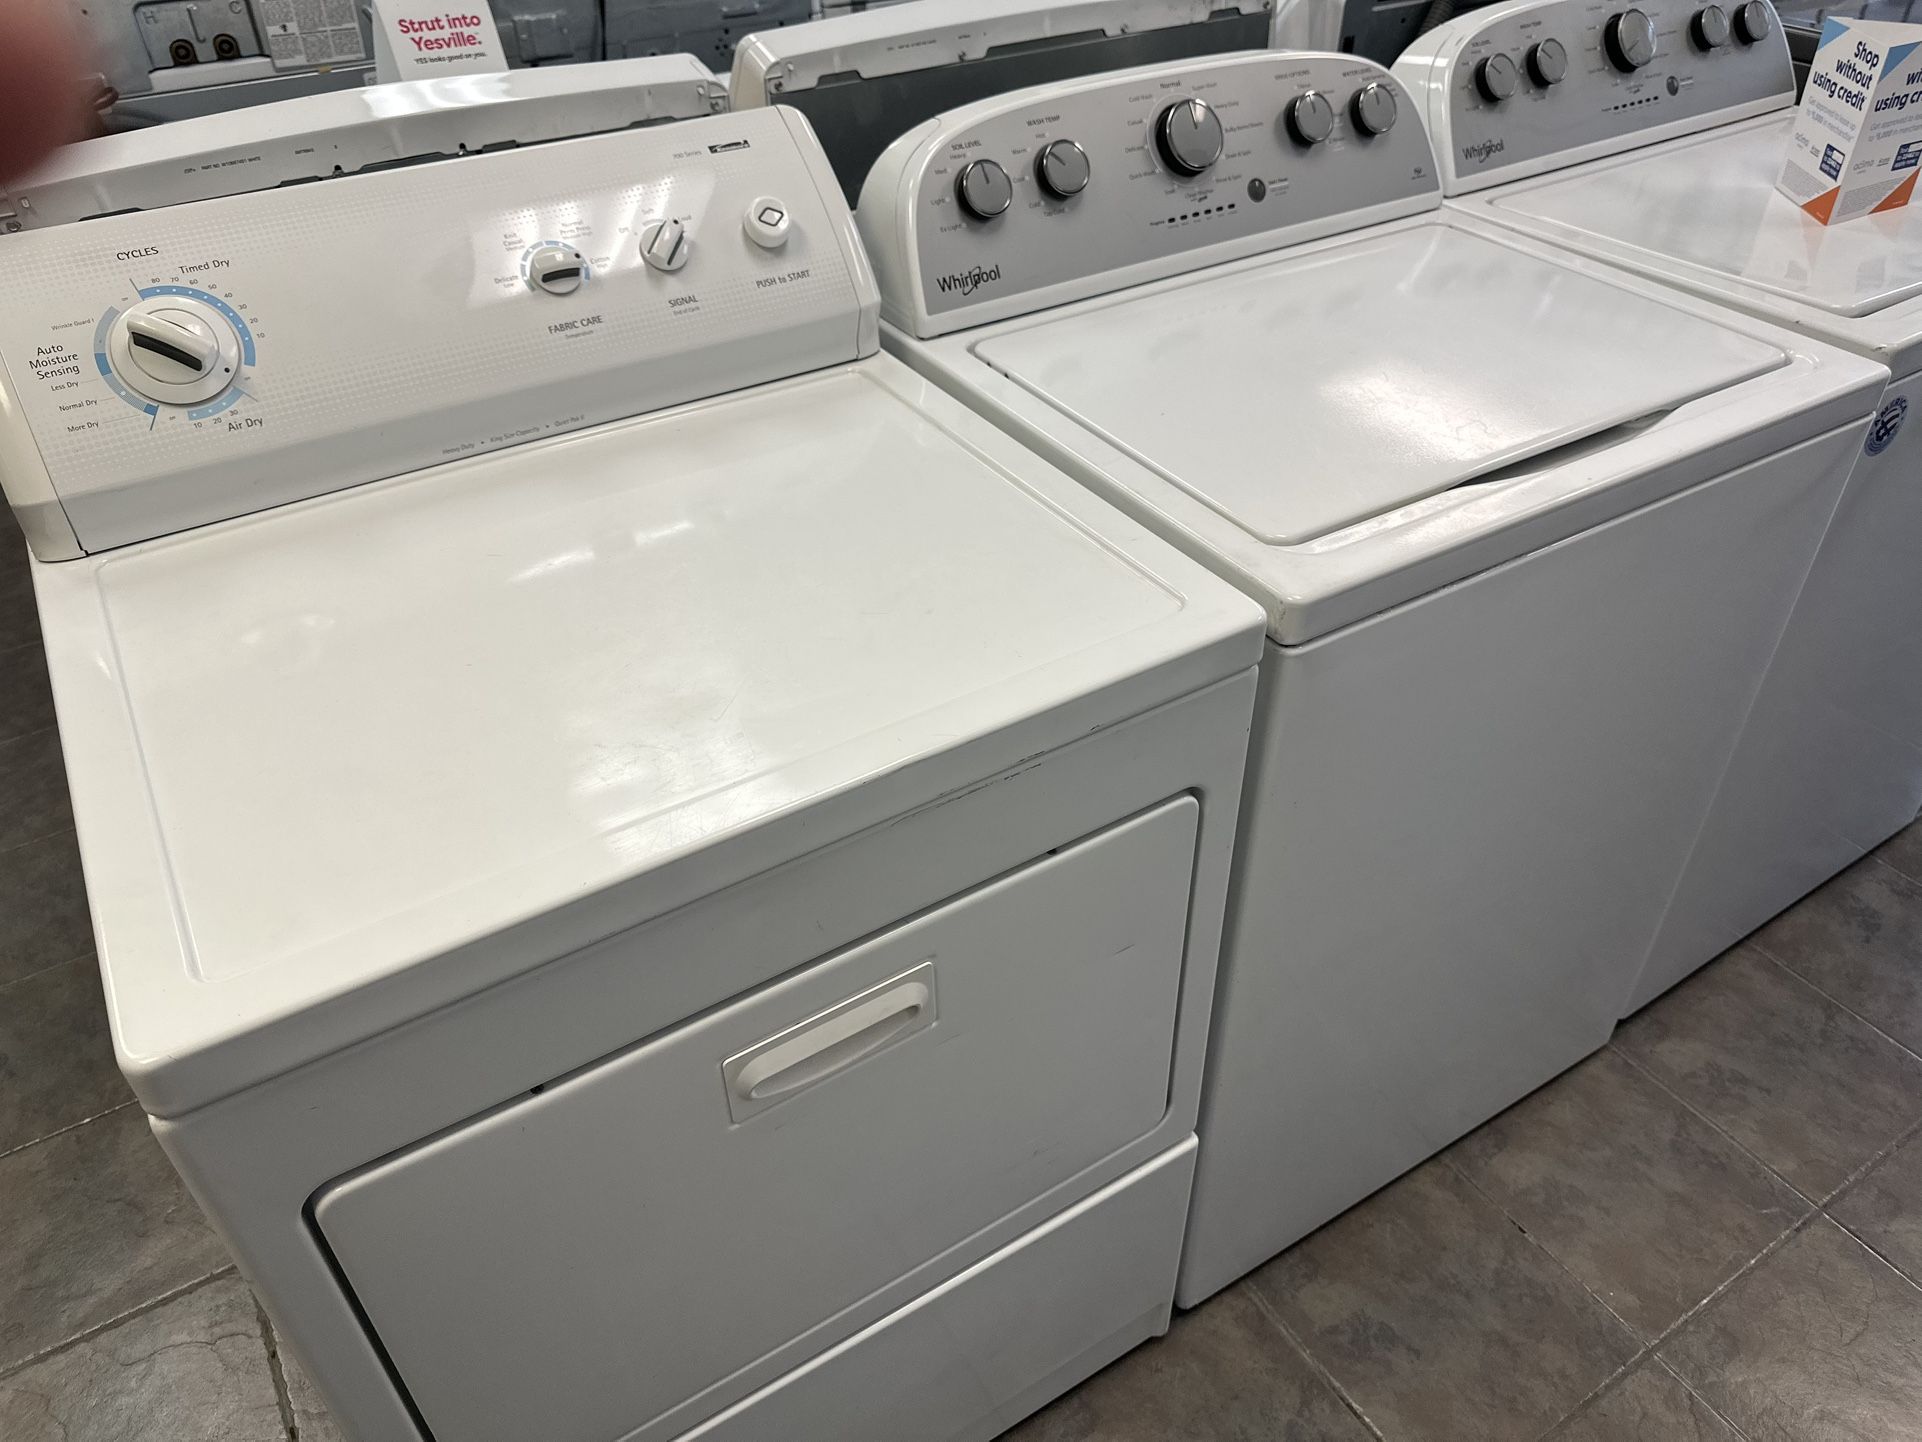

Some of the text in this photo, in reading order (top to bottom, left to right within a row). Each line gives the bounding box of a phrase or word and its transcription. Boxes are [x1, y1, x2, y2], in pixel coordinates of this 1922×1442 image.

[398, 13, 481, 34] Strut into
[411, 31, 482, 52] Yesville.
[1854, 40, 1880, 69] Shop
[1835, 58, 1874, 91] without
[1160, 80, 1181, 89] Normal
[1812, 69, 1866, 111] using credit
[1874, 91, 1909, 112] using
[964, 139, 982, 149] LEVEL
[1462, 139, 1504, 163] Whirlpool
[116, 246, 159, 261] CYCLES
[178, 258, 231, 274] Timed Dry
[756, 269, 811, 289] PUSH to START
[936, 264, 1001, 296] Whirlpool
[668, 294, 699, 308] SIGNAL
[51, 323, 73, 331] Wrinkle
[73, 319, 91, 327] Guard
[548, 314, 604, 334] FABRIC CARE
[37, 344, 64, 356] Auto
[29, 352, 79, 370] Moisture
[36, 364, 80, 380] Sensing
[51, 383, 66, 392] Less
[59, 399, 98, 412] Normal Dry
[67, 421, 99, 432] More Dry
[212, 417, 222, 425] 20
[227, 417, 263, 432] Air Dry
